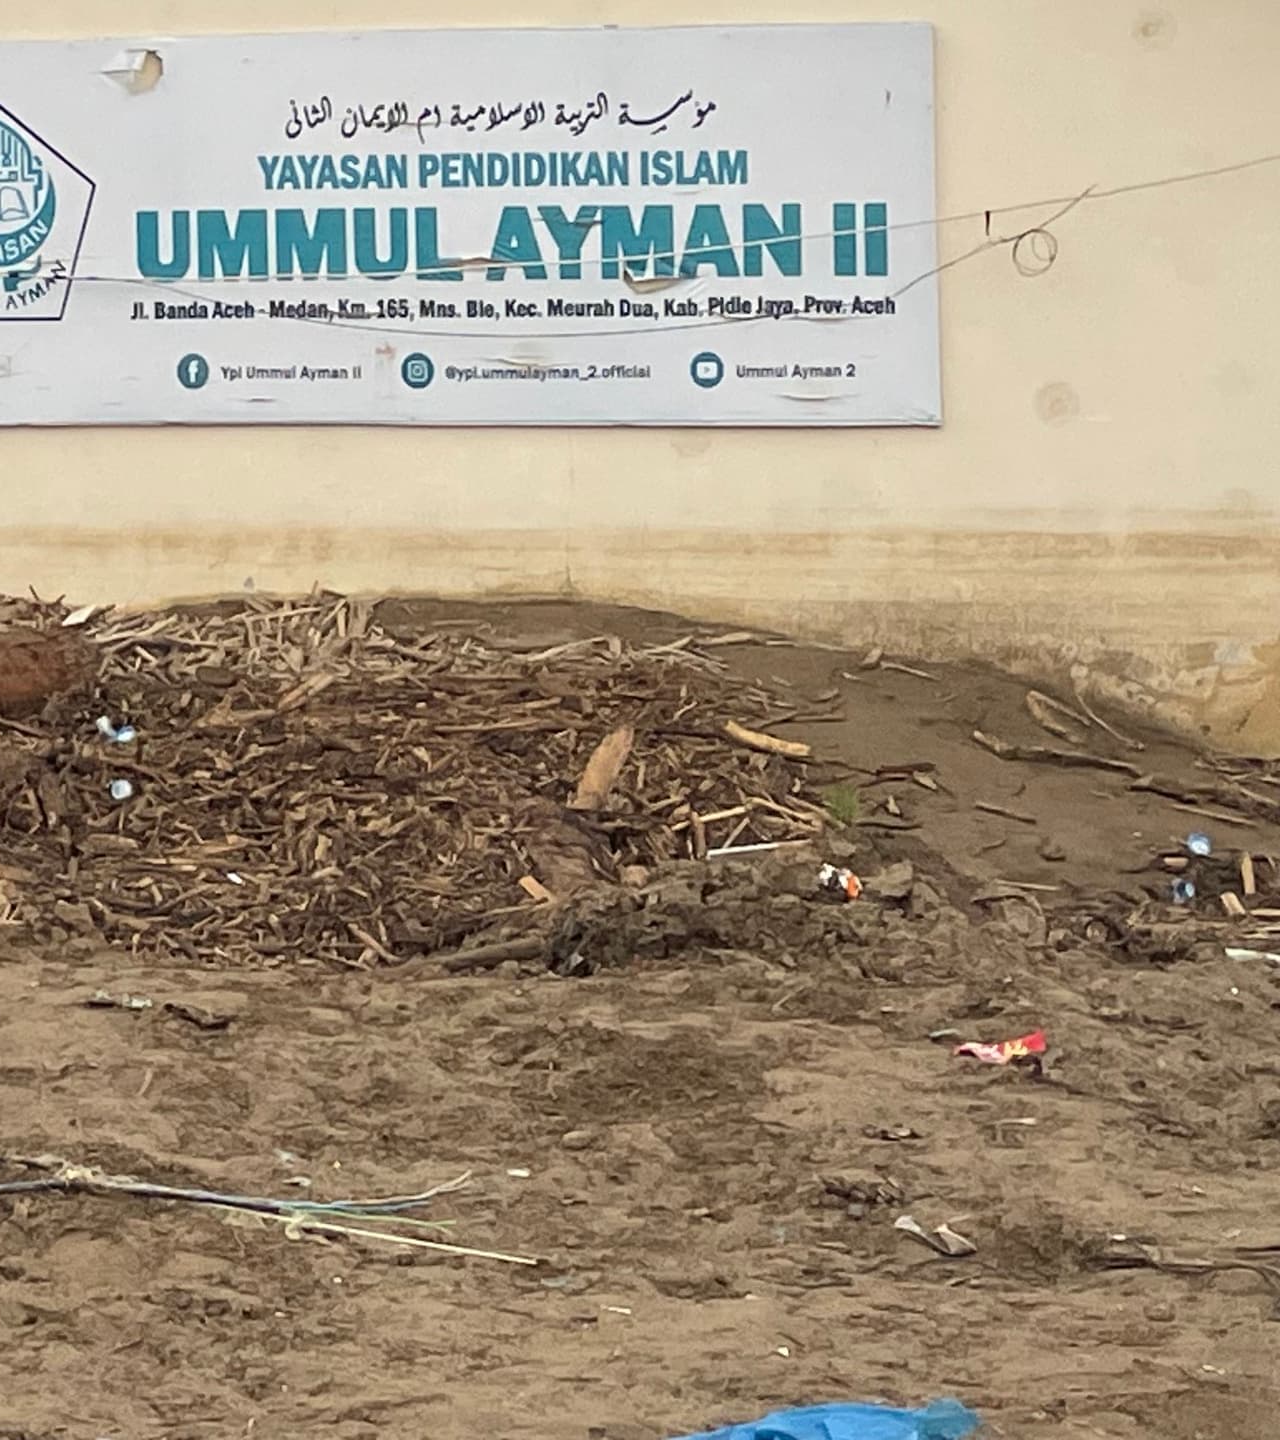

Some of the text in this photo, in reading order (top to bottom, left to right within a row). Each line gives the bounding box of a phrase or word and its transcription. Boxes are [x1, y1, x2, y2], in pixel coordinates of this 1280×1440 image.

[258, 149, 748, 190] YAYASAN PENDIDIKAN ISLAM
[136, 202, 888, 283] UMMUL AYMAN II
[4, 258, 67, 311] AYMAN
[130, 302, 149, 320] Jl.
[154, 301, 208, 320] Banda
[212, 300, 255, 319] Aceh
[269, 300, 334, 323] Medan,
[376, 298, 415, 321] 165,
[419, 299, 462, 318] Mns.
[505, 299, 542, 318] Kec.
[547, 298, 615, 318] Meurah
[619, 298, 659, 320] Dua,
[708, 296, 752, 320] Pidie
[804, 295, 847, 315] Prov.
[851, 295, 896, 315] Aceh
[246, 365, 296, 380] Ummul
[300, 365, 349, 381] Ayman
[736, 363, 856, 381] Ummul Ayman 2
